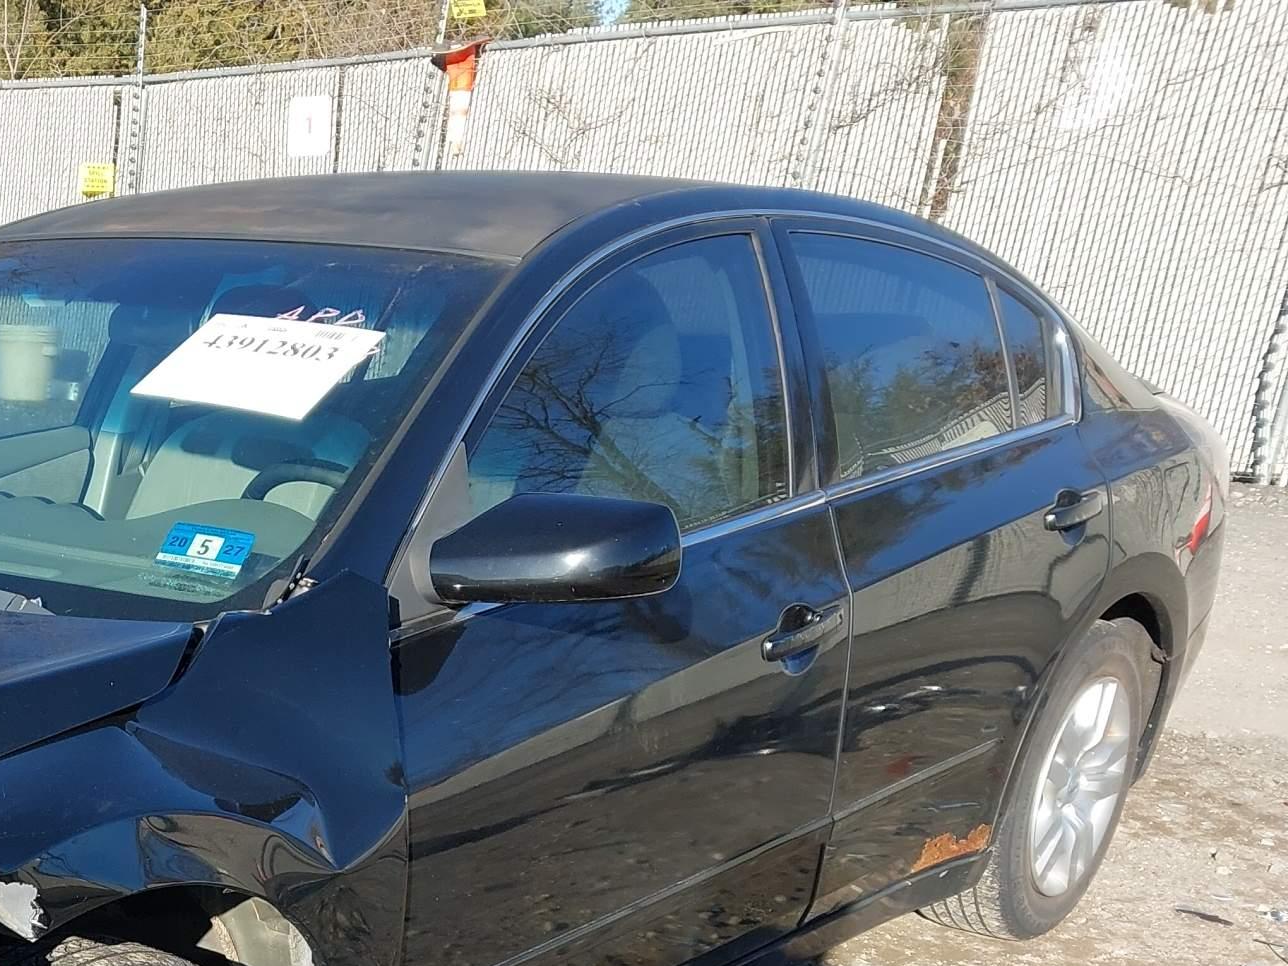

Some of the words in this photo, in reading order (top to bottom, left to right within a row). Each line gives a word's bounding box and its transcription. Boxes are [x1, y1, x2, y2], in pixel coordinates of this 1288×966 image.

[203, 333, 340, 362] 43912803
[167, 535, 189, 548] 20
[196, 538, 213, 556] 5
[223, 544, 246, 558] 27
